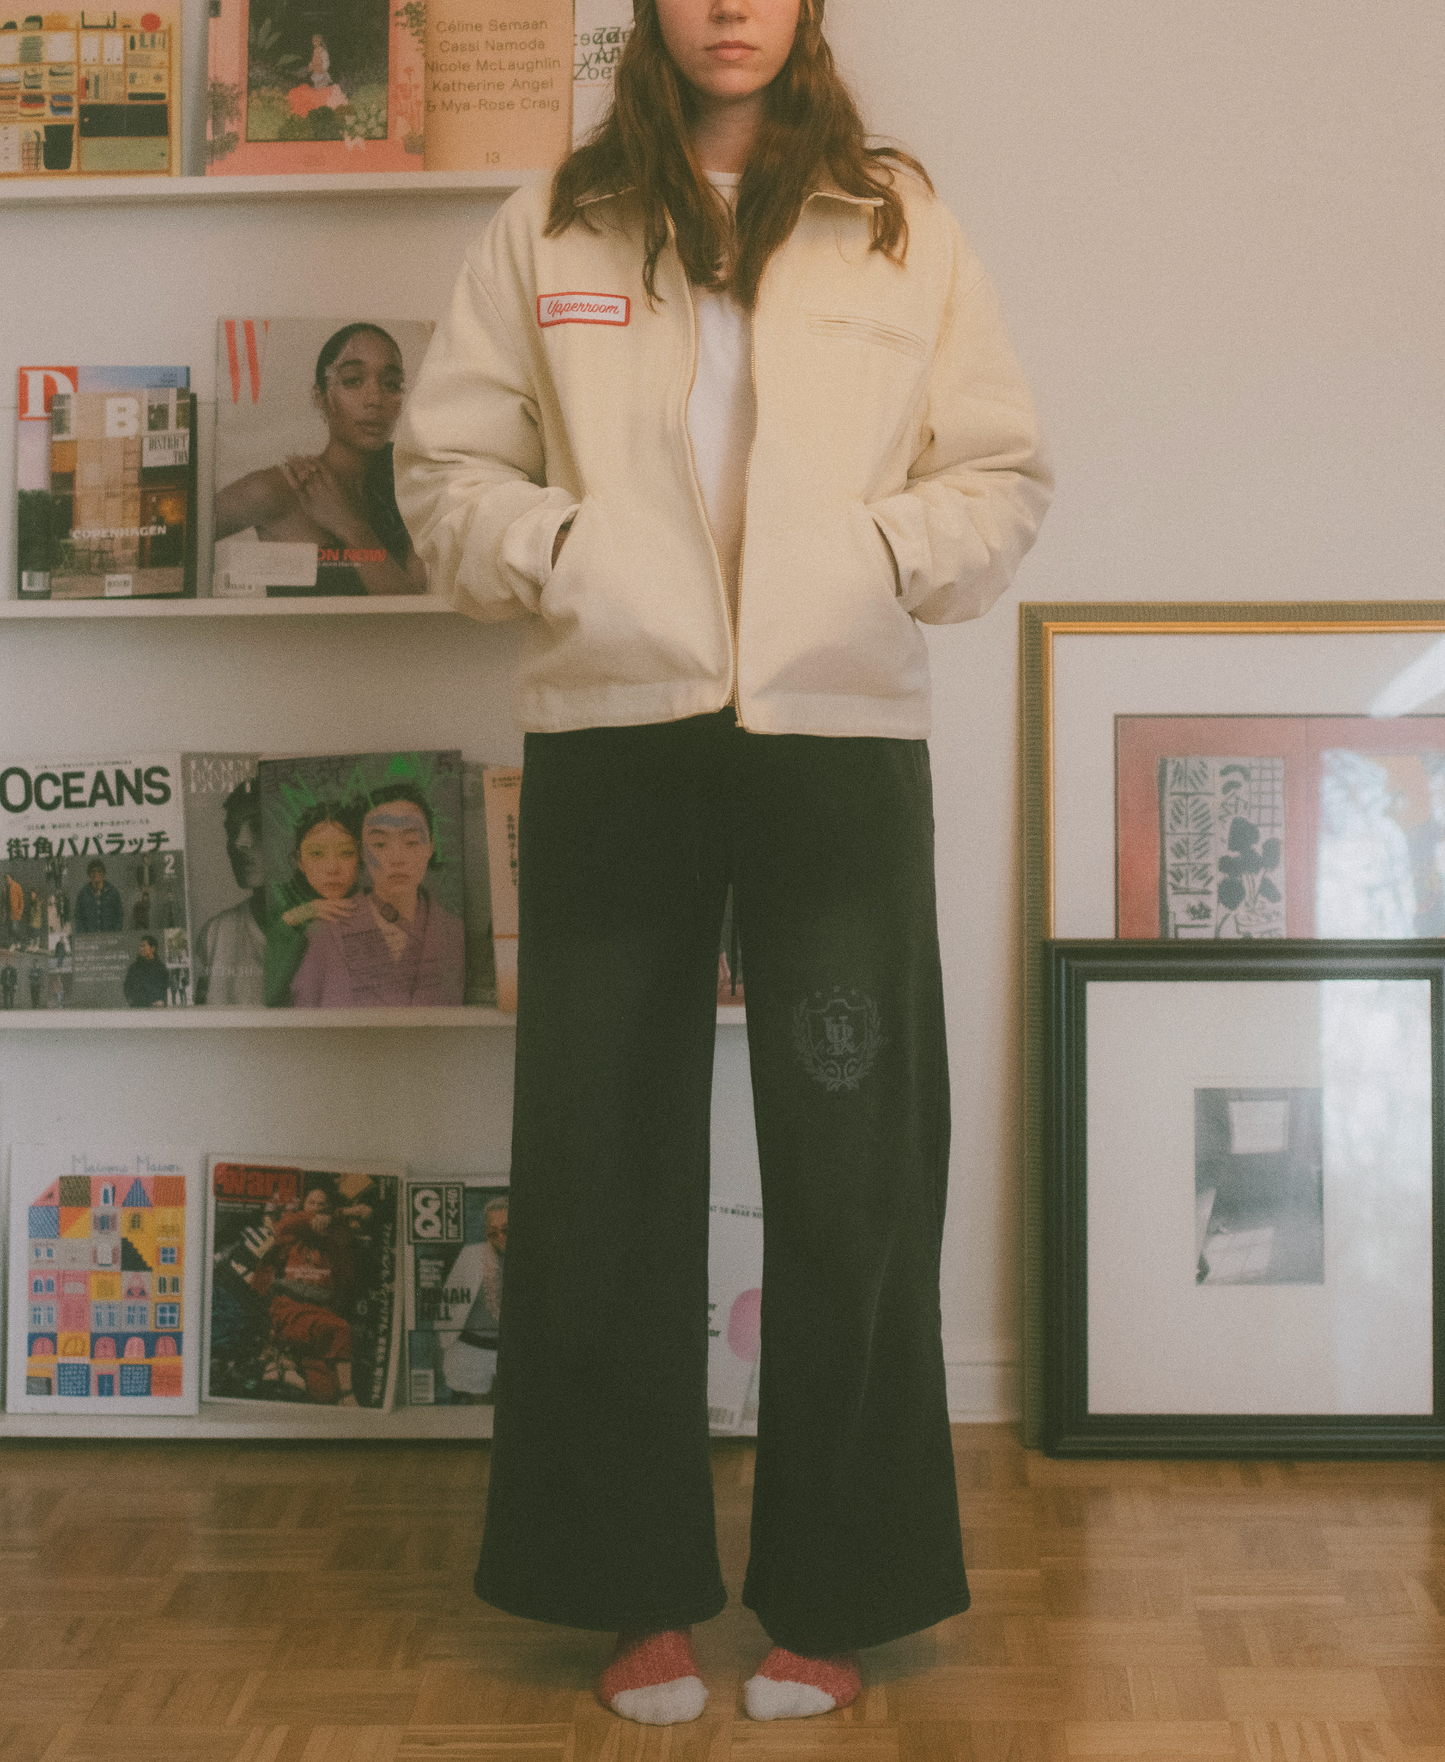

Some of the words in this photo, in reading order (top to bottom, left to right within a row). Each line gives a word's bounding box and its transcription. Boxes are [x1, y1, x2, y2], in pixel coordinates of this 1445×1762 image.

[436, 19, 483, 33] Céline
[488, 18, 548, 32] Semaan
[440, 40, 480, 53] Cassi
[485, 38, 546, 51] Namoda
[424, 60, 471, 72] Nicole
[476, 58, 562, 73] McLaughlin
[432, 79, 506, 92] Katherine
[510, 77, 554, 93] Angel
[441, 98, 515, 114] Mya-Rose
[520, 97, 560, 112] Craig
[485, 151, 501, 164] 13
[546, 299, 620, 317] Upperroom
[105, 397, 141, 438] B
[72, 525, 167, 540] COPENHAGEN
[343, 548, 387, 561] NOW
[0, 766, 171, 813] OCEANS
[6, 830, 170, 861] 街角パパラッチ
[164, 854, 176, 874] 2
[413, 1189, 442, 1239] GQ
[447, 1188, 460, 1238] STYLE
